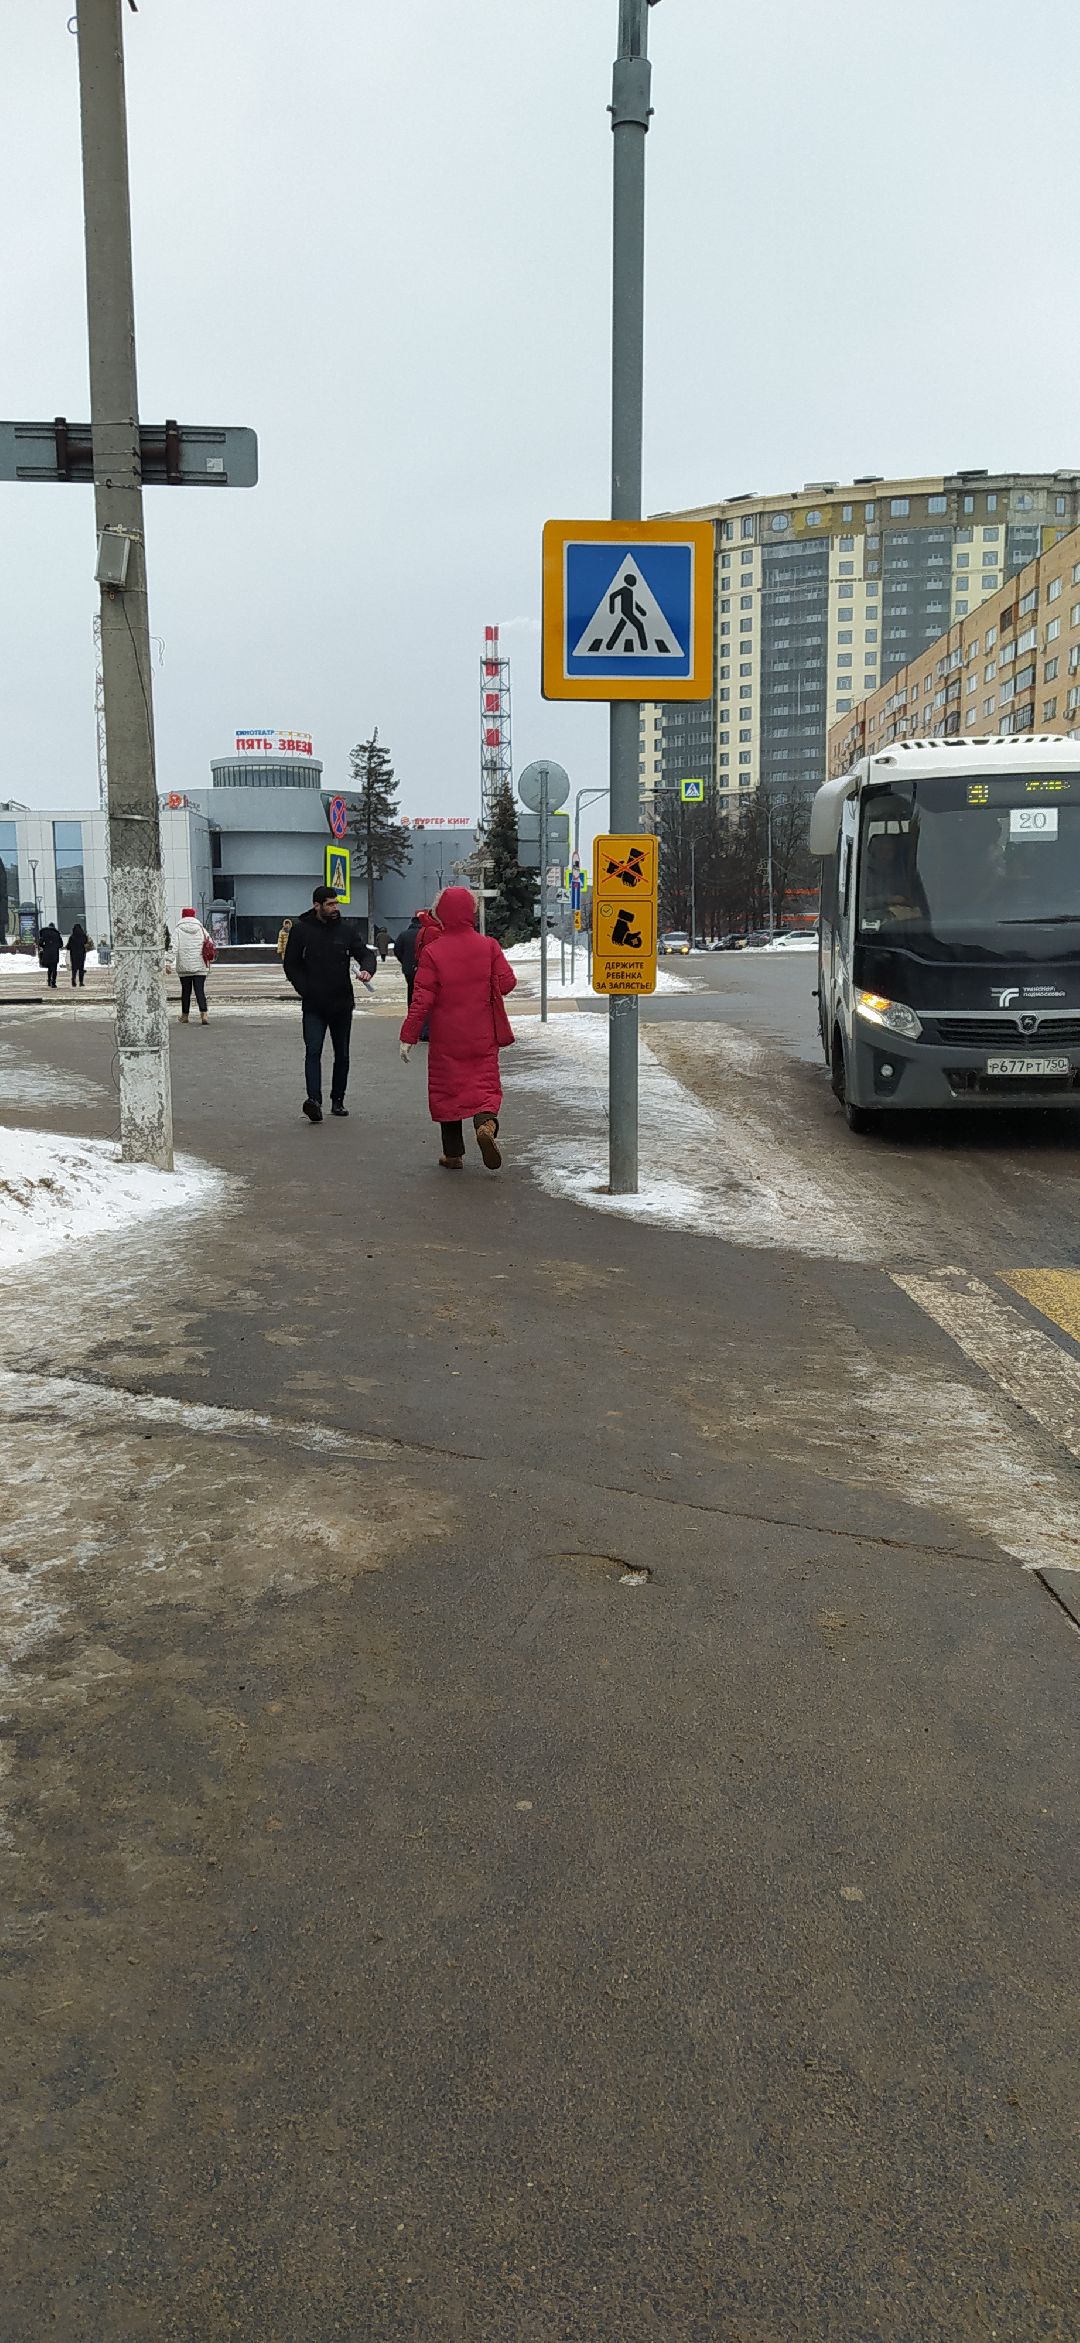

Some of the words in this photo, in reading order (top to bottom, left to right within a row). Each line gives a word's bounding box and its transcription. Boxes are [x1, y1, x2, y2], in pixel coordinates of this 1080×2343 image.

[236, 738, 273, 750] ПЯТЬ
[278, 738, 312, 755] ЗВЕЗД
[447, 817, 470, 825] КИНГ
[1019, 812, 1046, 829] 20
[605, 962, 644, 971] ДЕРЖИТЕ
[606, 971, 642, 979] РЕБЁНКА
